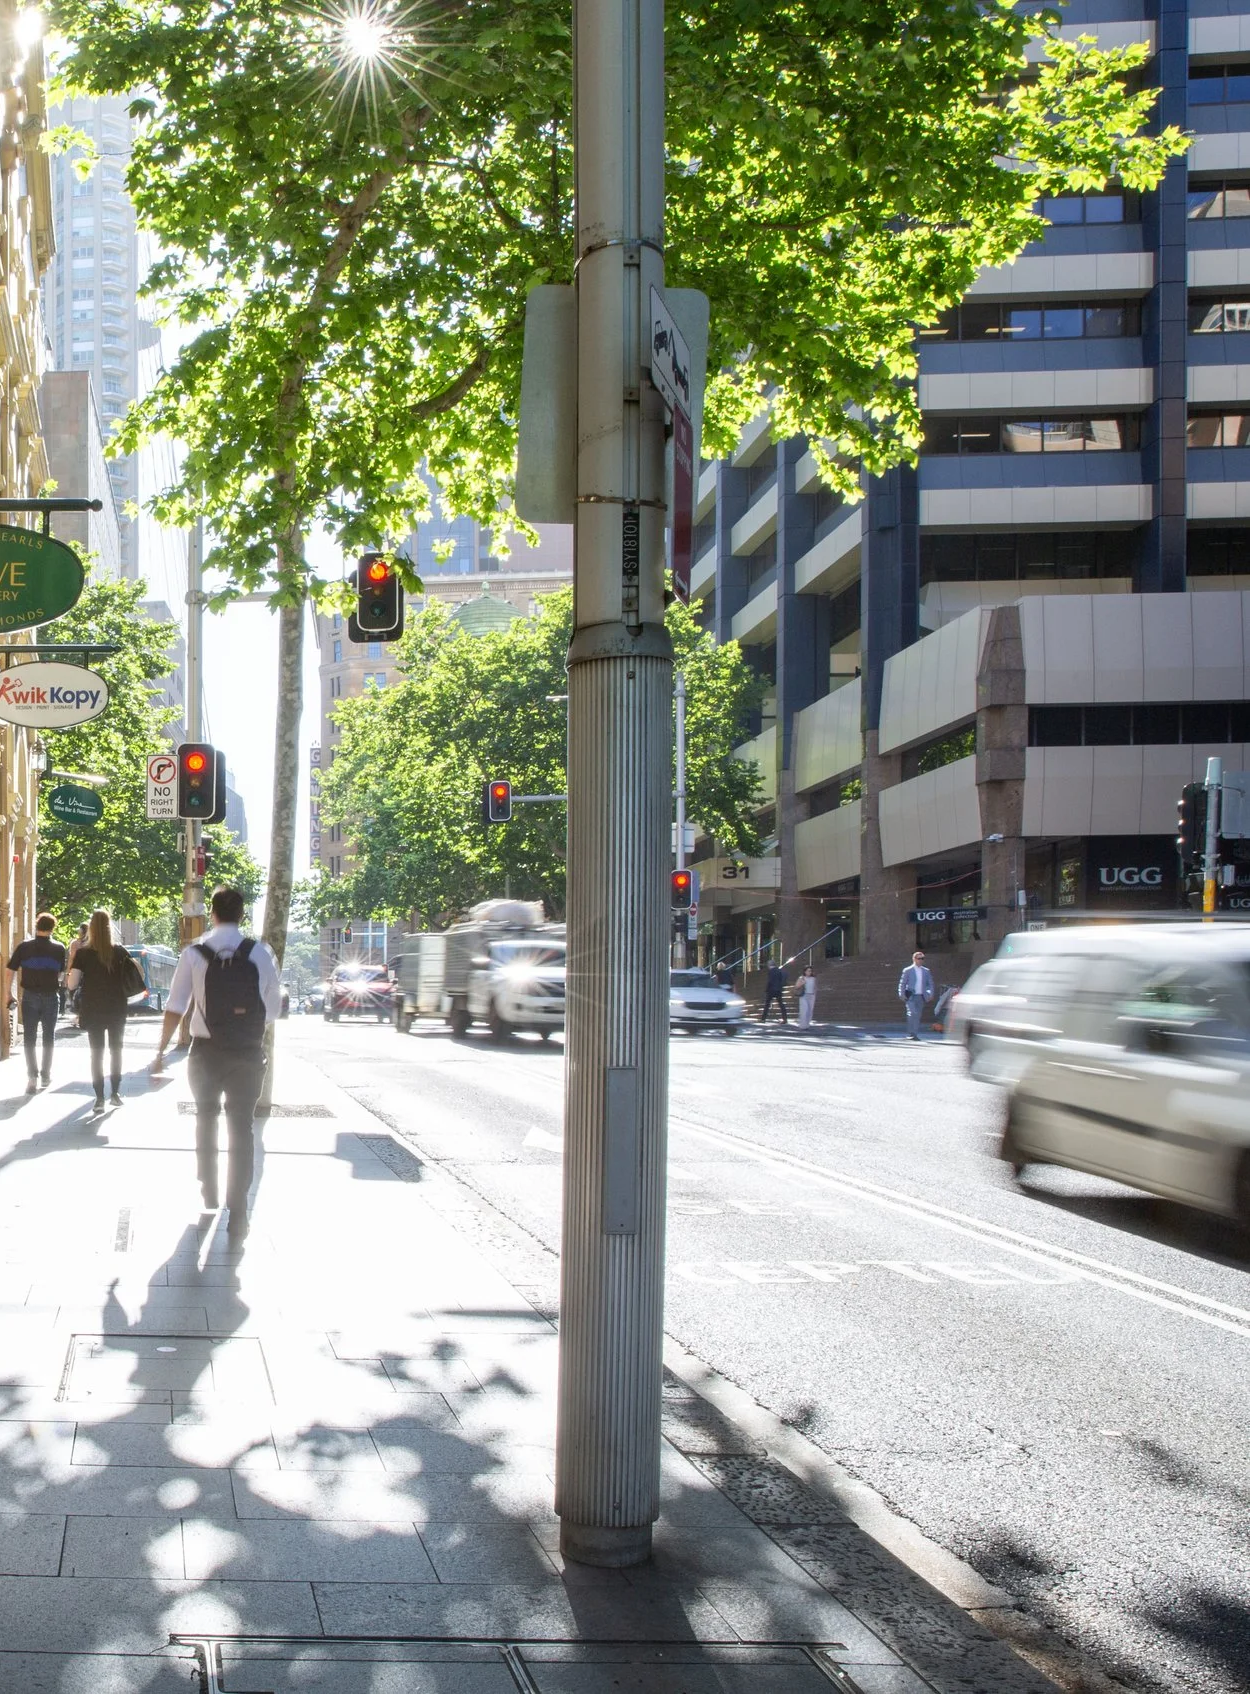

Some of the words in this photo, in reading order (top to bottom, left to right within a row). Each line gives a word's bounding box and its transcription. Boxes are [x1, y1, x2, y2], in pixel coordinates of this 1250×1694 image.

[623, 518, 638, 570] SY18101
[154, 786, 171, 797] NO
[150, 798, 174, 806] RIGHT
[310, 749, 321, 868] GWING
[722, 866, 750, 880] 31
[1099, 867, 1163, 885] UGG
[1230, 898, 1250, 908] UG
[916, 911, 946, 922] UGG
[666, 1199, 854, 1217] SES
[671, 1260, 1080, 1285] CEPTED
